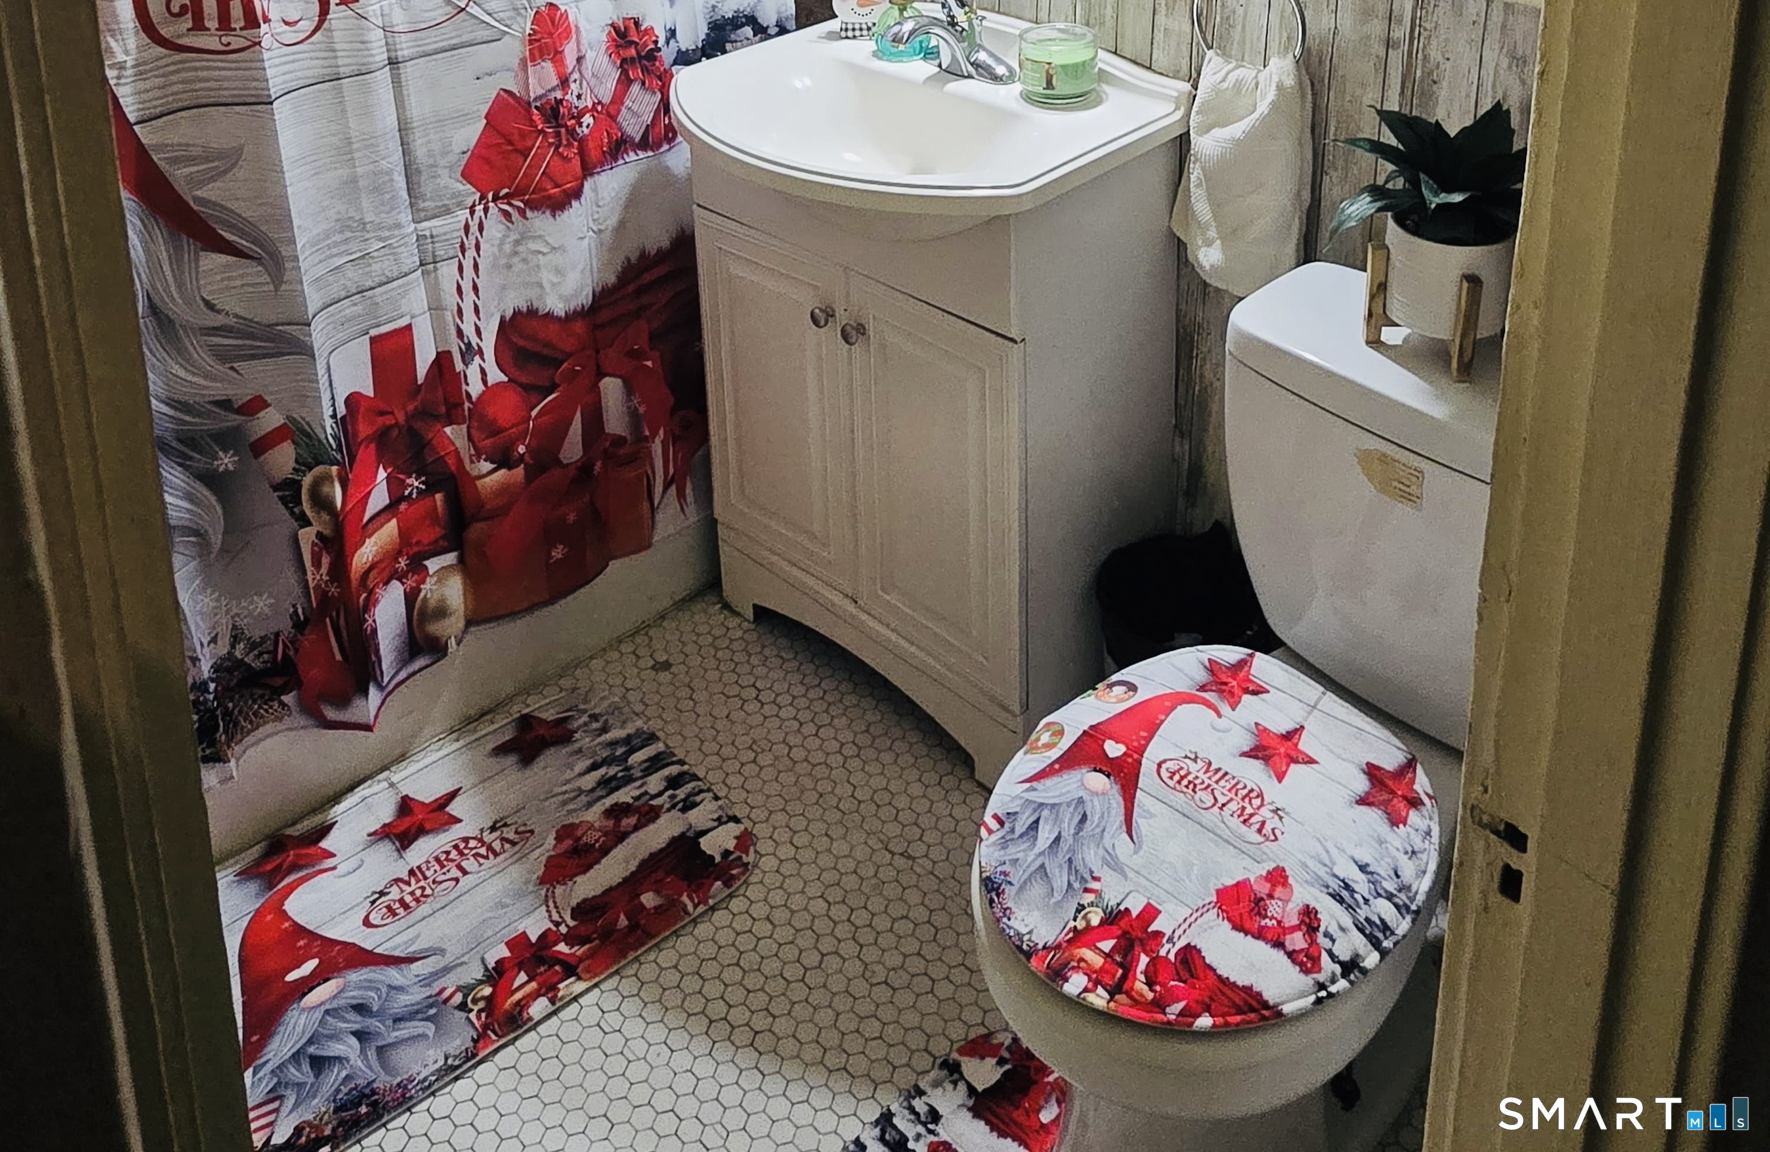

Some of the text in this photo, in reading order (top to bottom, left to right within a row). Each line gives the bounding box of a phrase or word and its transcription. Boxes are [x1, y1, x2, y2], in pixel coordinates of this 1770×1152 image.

[1156, 757, 1285, 845] CHRISTMAS
[1197, 756, 1270, 816] MERRY
[362, 826, 535, 928] CHRISTMAS
[384, 829, 489, 893] MERRY
